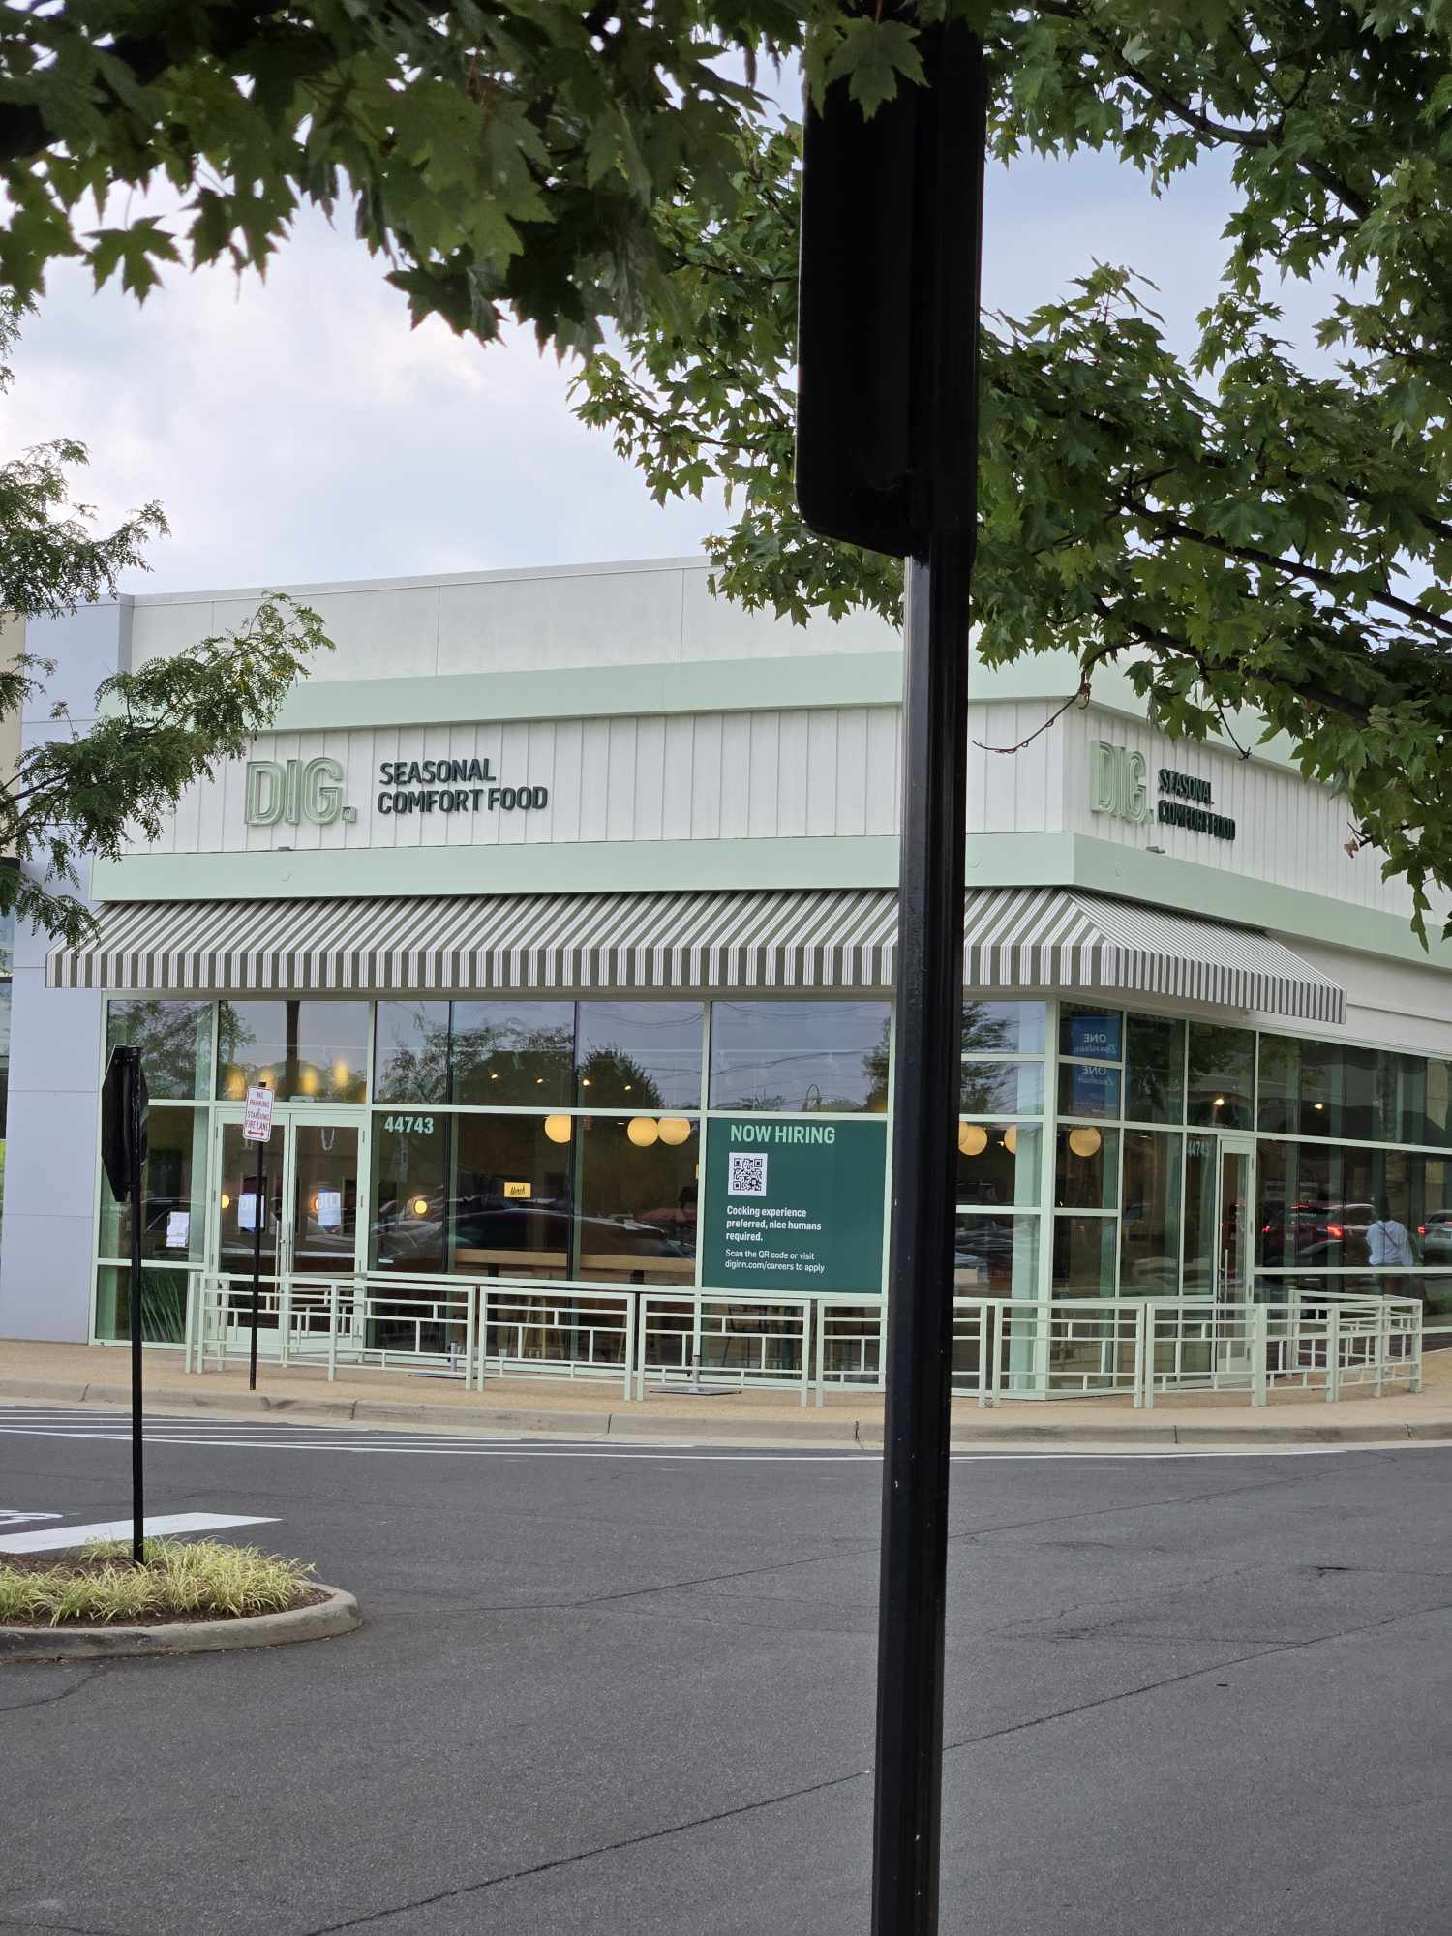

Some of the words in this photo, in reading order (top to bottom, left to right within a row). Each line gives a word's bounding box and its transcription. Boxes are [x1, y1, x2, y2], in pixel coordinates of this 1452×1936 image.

[379, 758, 497, 785] SEASONAL
[246, 757, 357, 827] DIG.
[377, 788, 484, 815] COMFORT
[487, 786, 549, 811] FOOD
[384, 1115, 434, 1135] 44743
[730, 1125, 771, 1143] NOW
[775, 1127, 835, 1144] HIRING
[726, 1206, 760, 1218] Cooking
[761, 1207, 807, 1218] experience
[726, 1219, 769, 1230] preferred,
[769, 1220, 787, 1229] nice
[788, 1221, 822, 1231] humans
[726, 1231, 763, 1242] required.
[725, 1249, 743, 1258] Scan
[744, 1250, 757, 1258] the
[758, 1250, 770, 1259] QR
[770, 1251, 789, 1260] code
[800, 1252, 816, 1261] visit
[796, 1262, 803, 1271] to
[804, 1263, 826, 1274] apply
